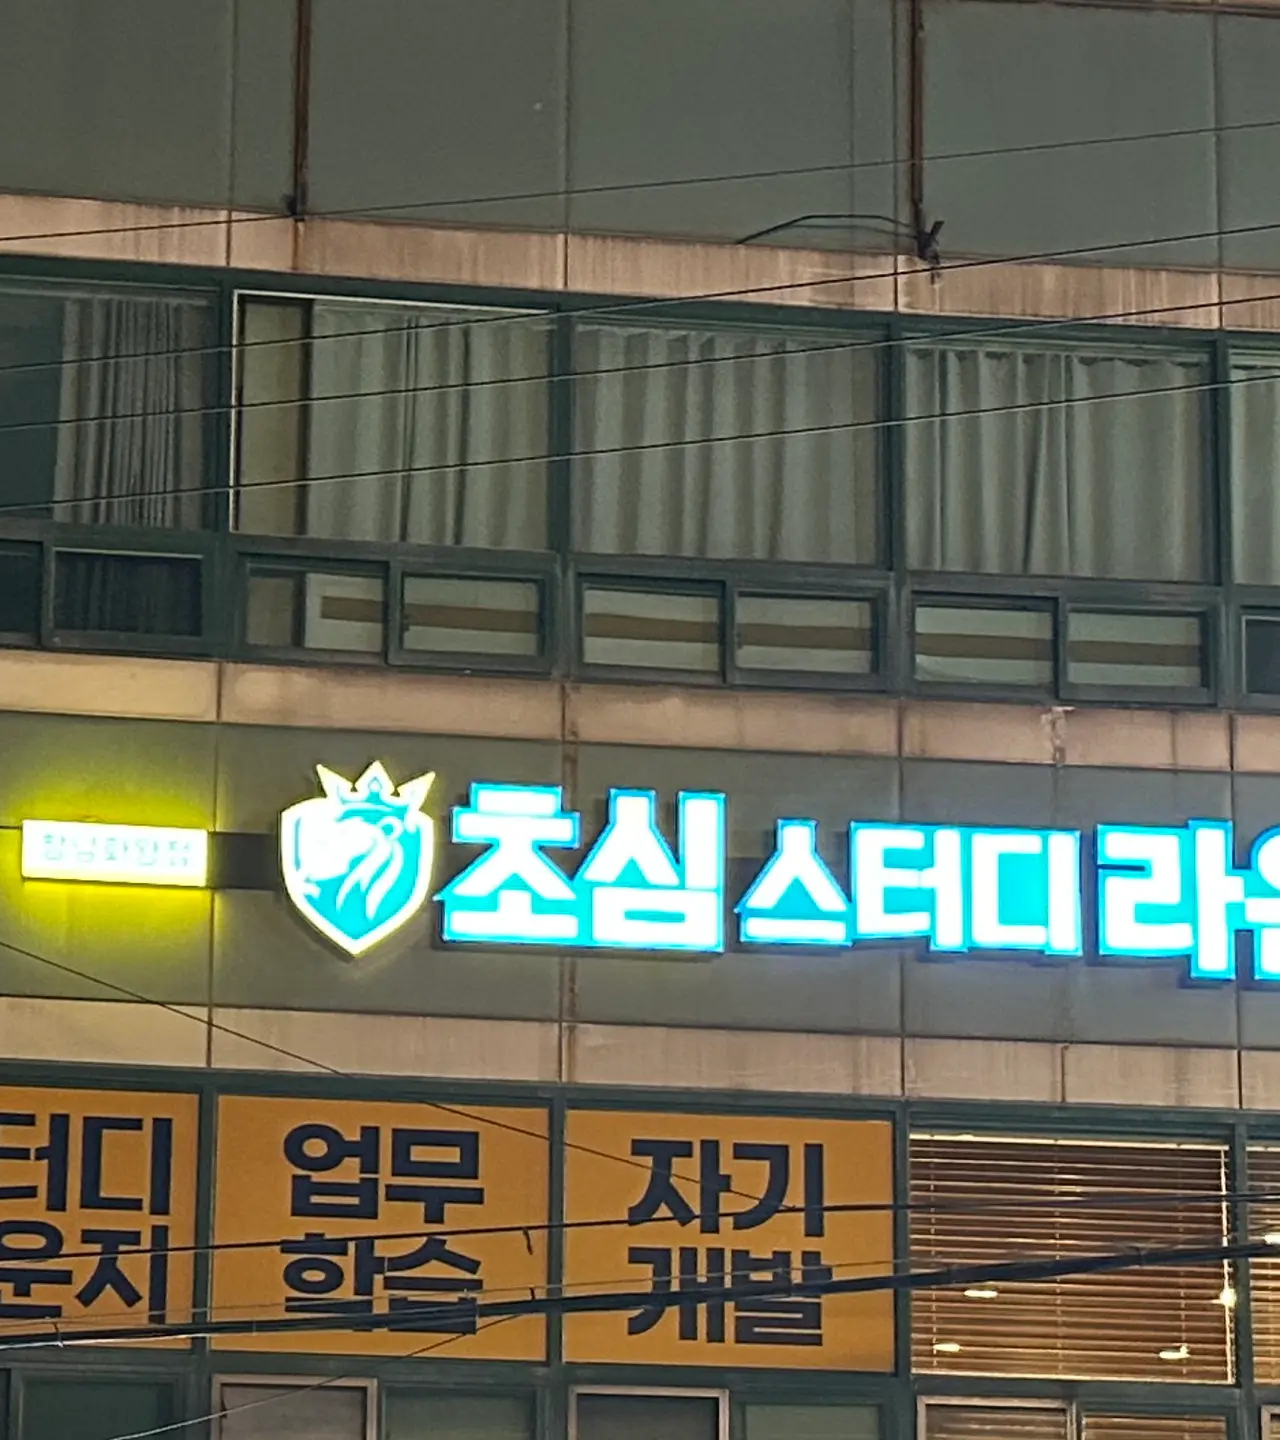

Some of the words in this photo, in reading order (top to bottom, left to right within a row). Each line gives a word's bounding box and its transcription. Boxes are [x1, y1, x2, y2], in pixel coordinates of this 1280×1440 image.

[435, 781, 726, 951] 초심
[282, 1122, 485, 1226] 업무
[627, 1137, 825, 1238] 자기
[279, 1231, 484, 1335] 학습
[627, 1246, 833, 1346] 개발
